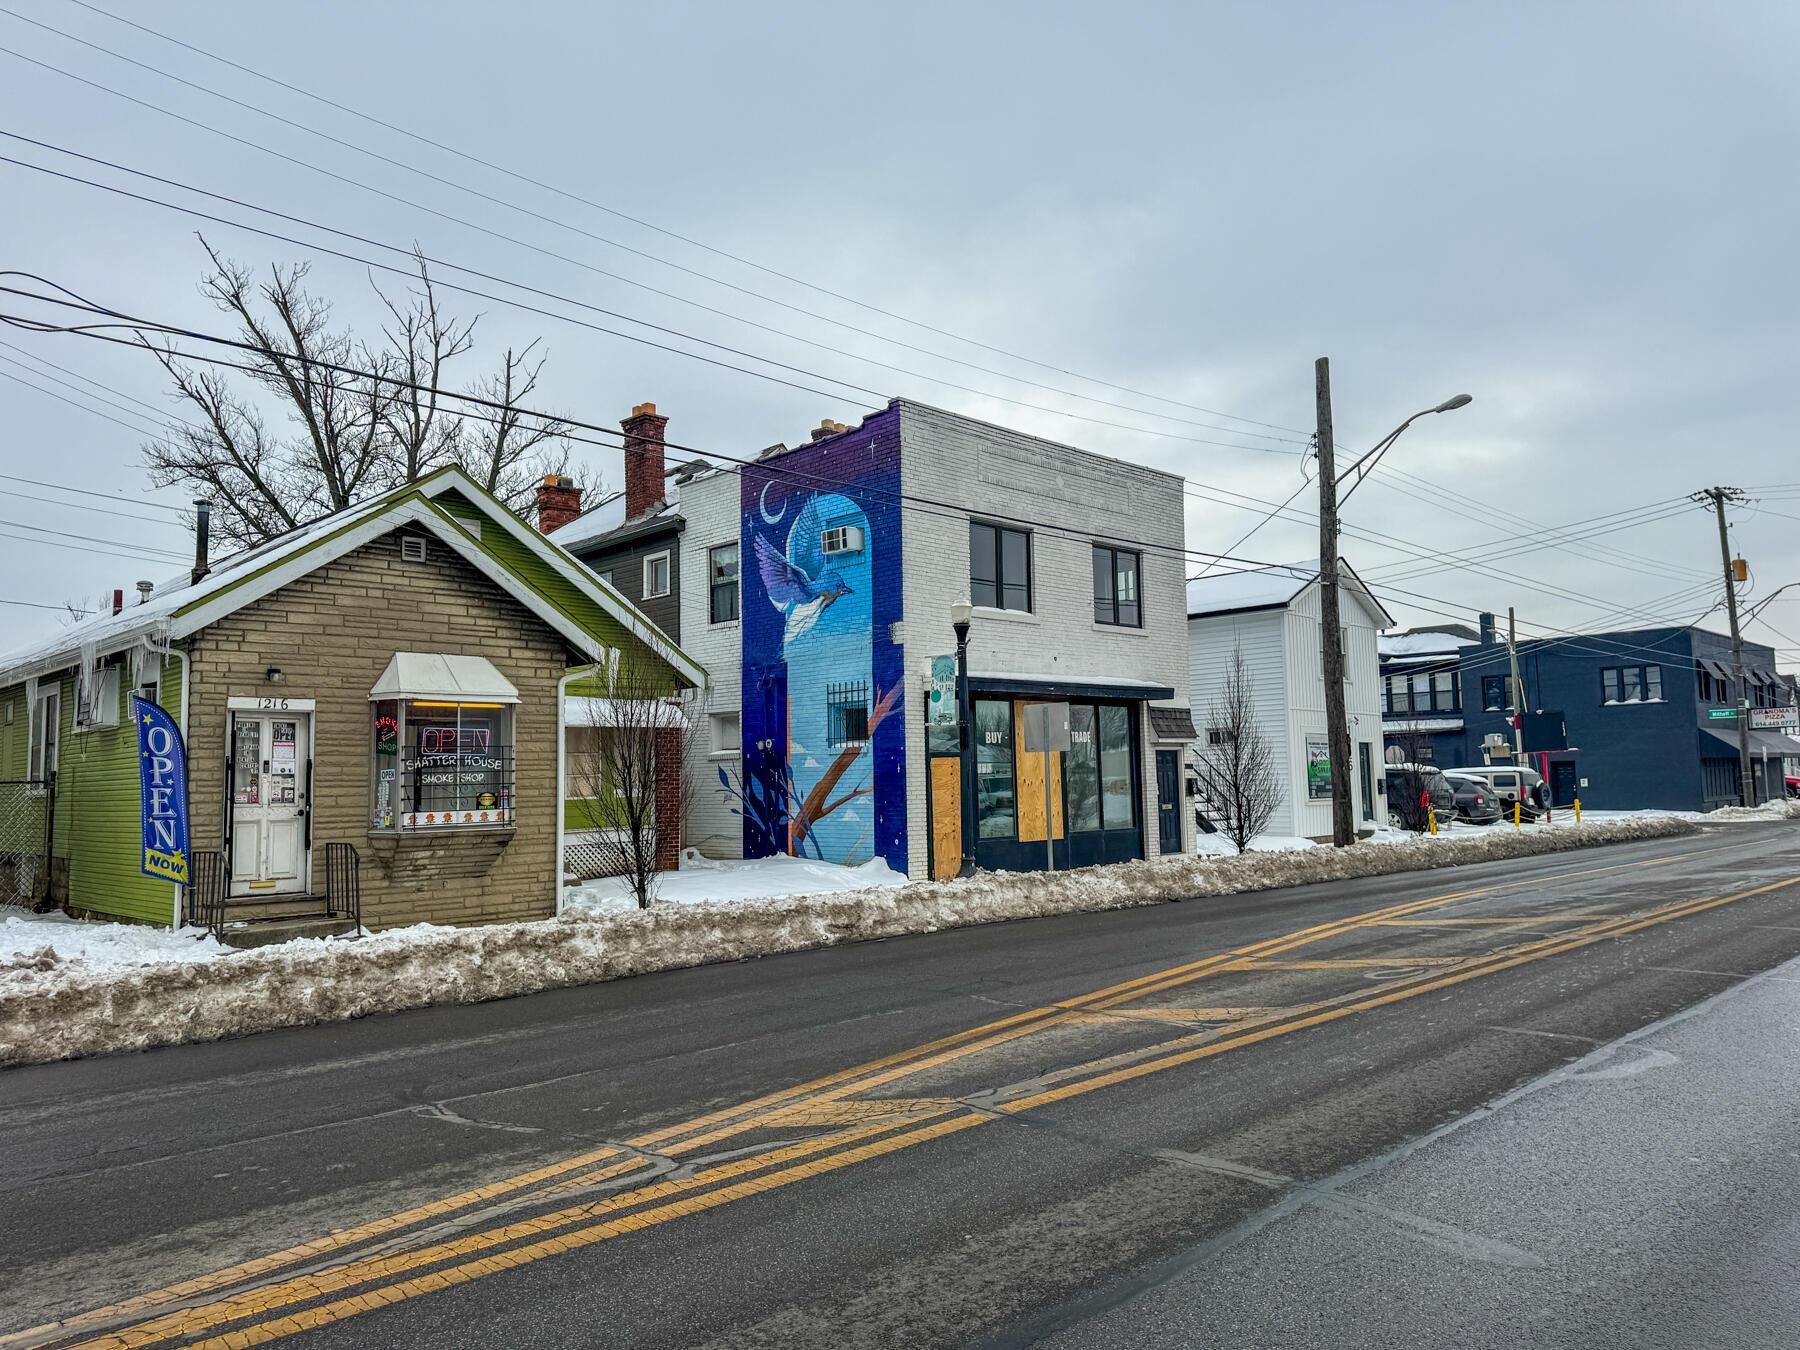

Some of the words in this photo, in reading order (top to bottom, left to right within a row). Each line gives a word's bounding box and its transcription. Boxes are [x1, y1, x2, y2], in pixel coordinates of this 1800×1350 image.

[258, 698, 288, 710] 1216
[424, 729, 488, 753] OPEN
[985, 731, 1002, 744] BUY
[1071, 731, 1091, 743] TRADE
[377, 741, 397, 752] SHOP
[406, 756, 457, 770] SHATTER
[464, 755, 502, 770] HOUSE
[381, 771, 395, 780] OPEN
[421, 774, 455, 784] SMOKE
[460, 773, 485, 783] SHOP
[147, 726, 176, 850] OPEN
[148, 854, 184, 875] NOW
